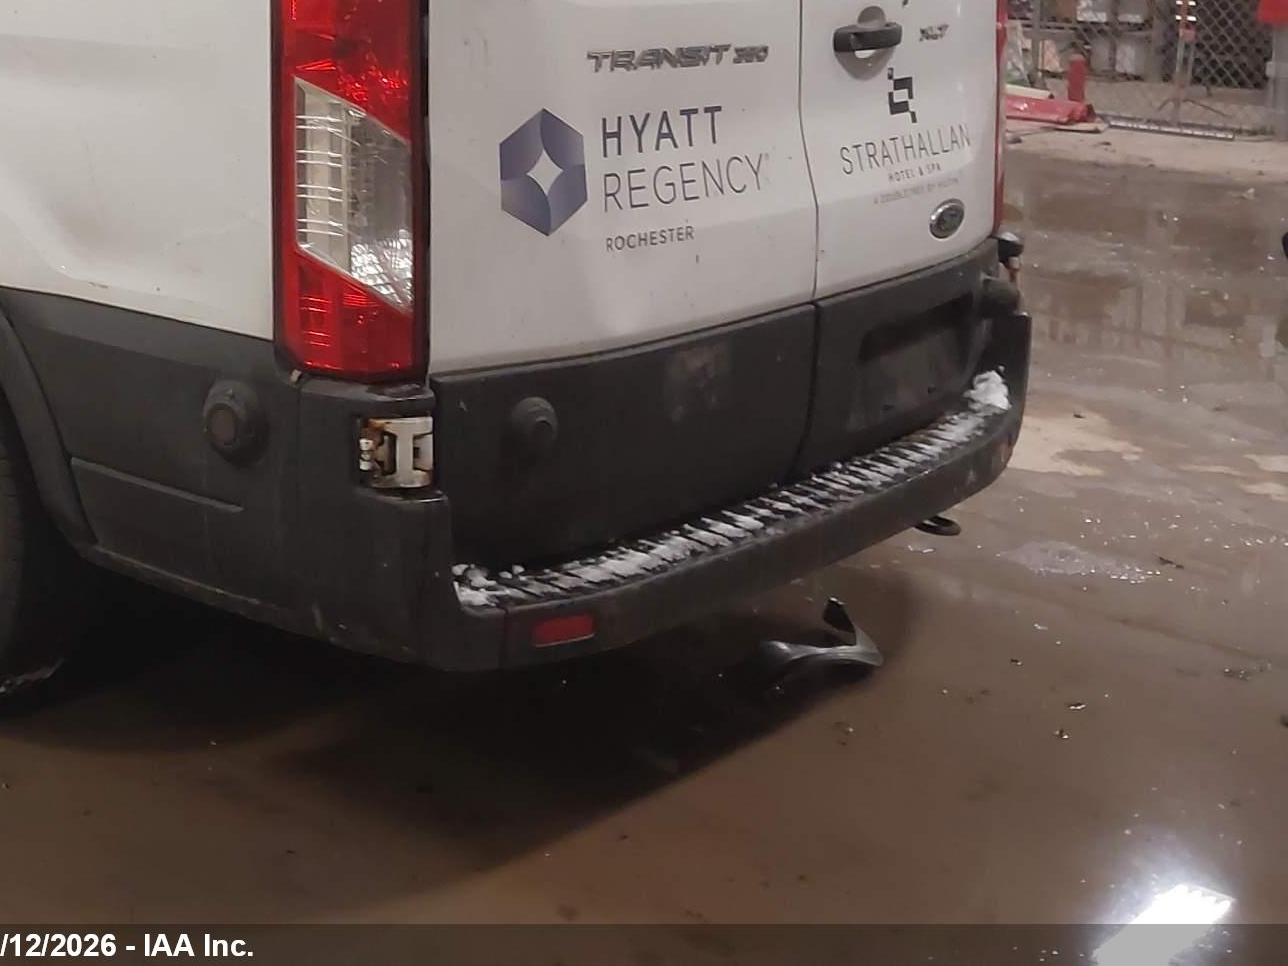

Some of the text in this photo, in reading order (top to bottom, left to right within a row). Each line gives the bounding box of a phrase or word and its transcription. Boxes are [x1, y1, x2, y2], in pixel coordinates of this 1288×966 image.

[587, 44, 731, 73] TRANSIT
[601, 106, 723, 159] HYATT
[840, 123, 972, 176] STRATHALLAN
[603, 154, 765, 213] REGENCY
[888, 167, 916, 182] HOTEL
[926, 161, 942, 175] SPA
[606, 225, 696, 252] ROCHESTER
